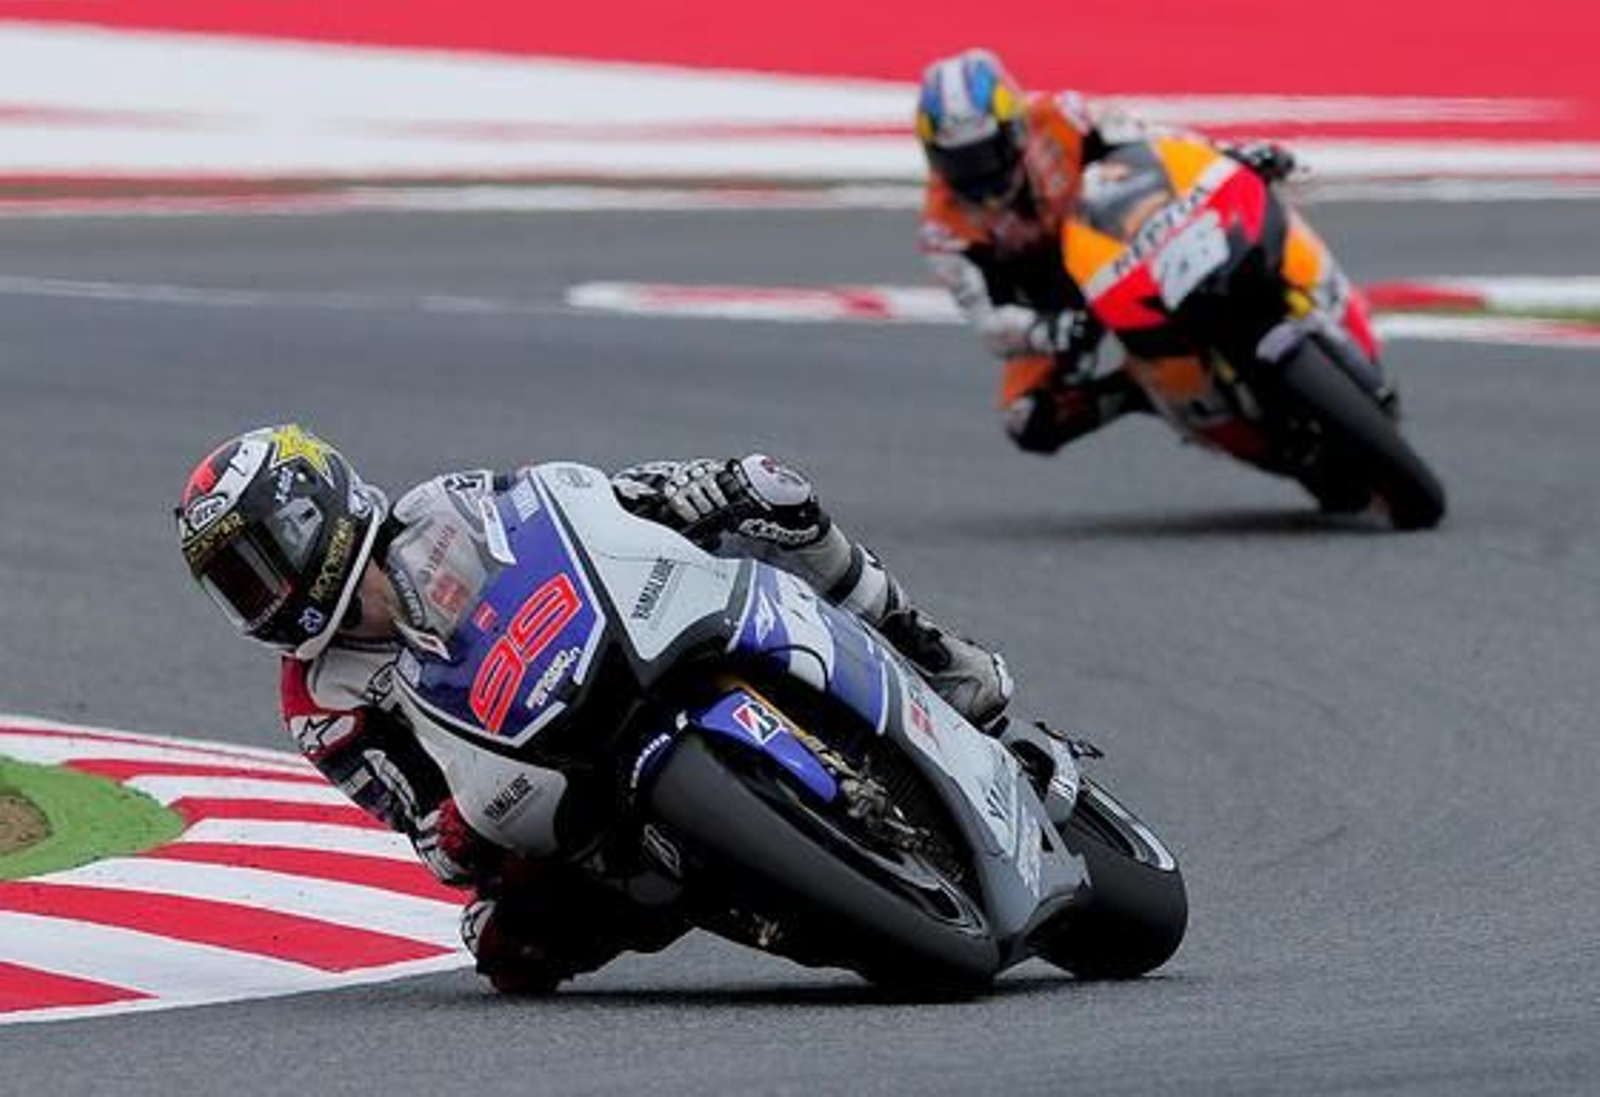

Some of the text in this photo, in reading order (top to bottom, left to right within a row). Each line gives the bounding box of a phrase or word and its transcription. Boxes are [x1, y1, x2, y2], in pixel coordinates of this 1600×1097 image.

[632, 557, 675, 620] YAMALUBE
[469, 573, 583, 734] 99
[483, 772, 535, 821] YAMALUBE
